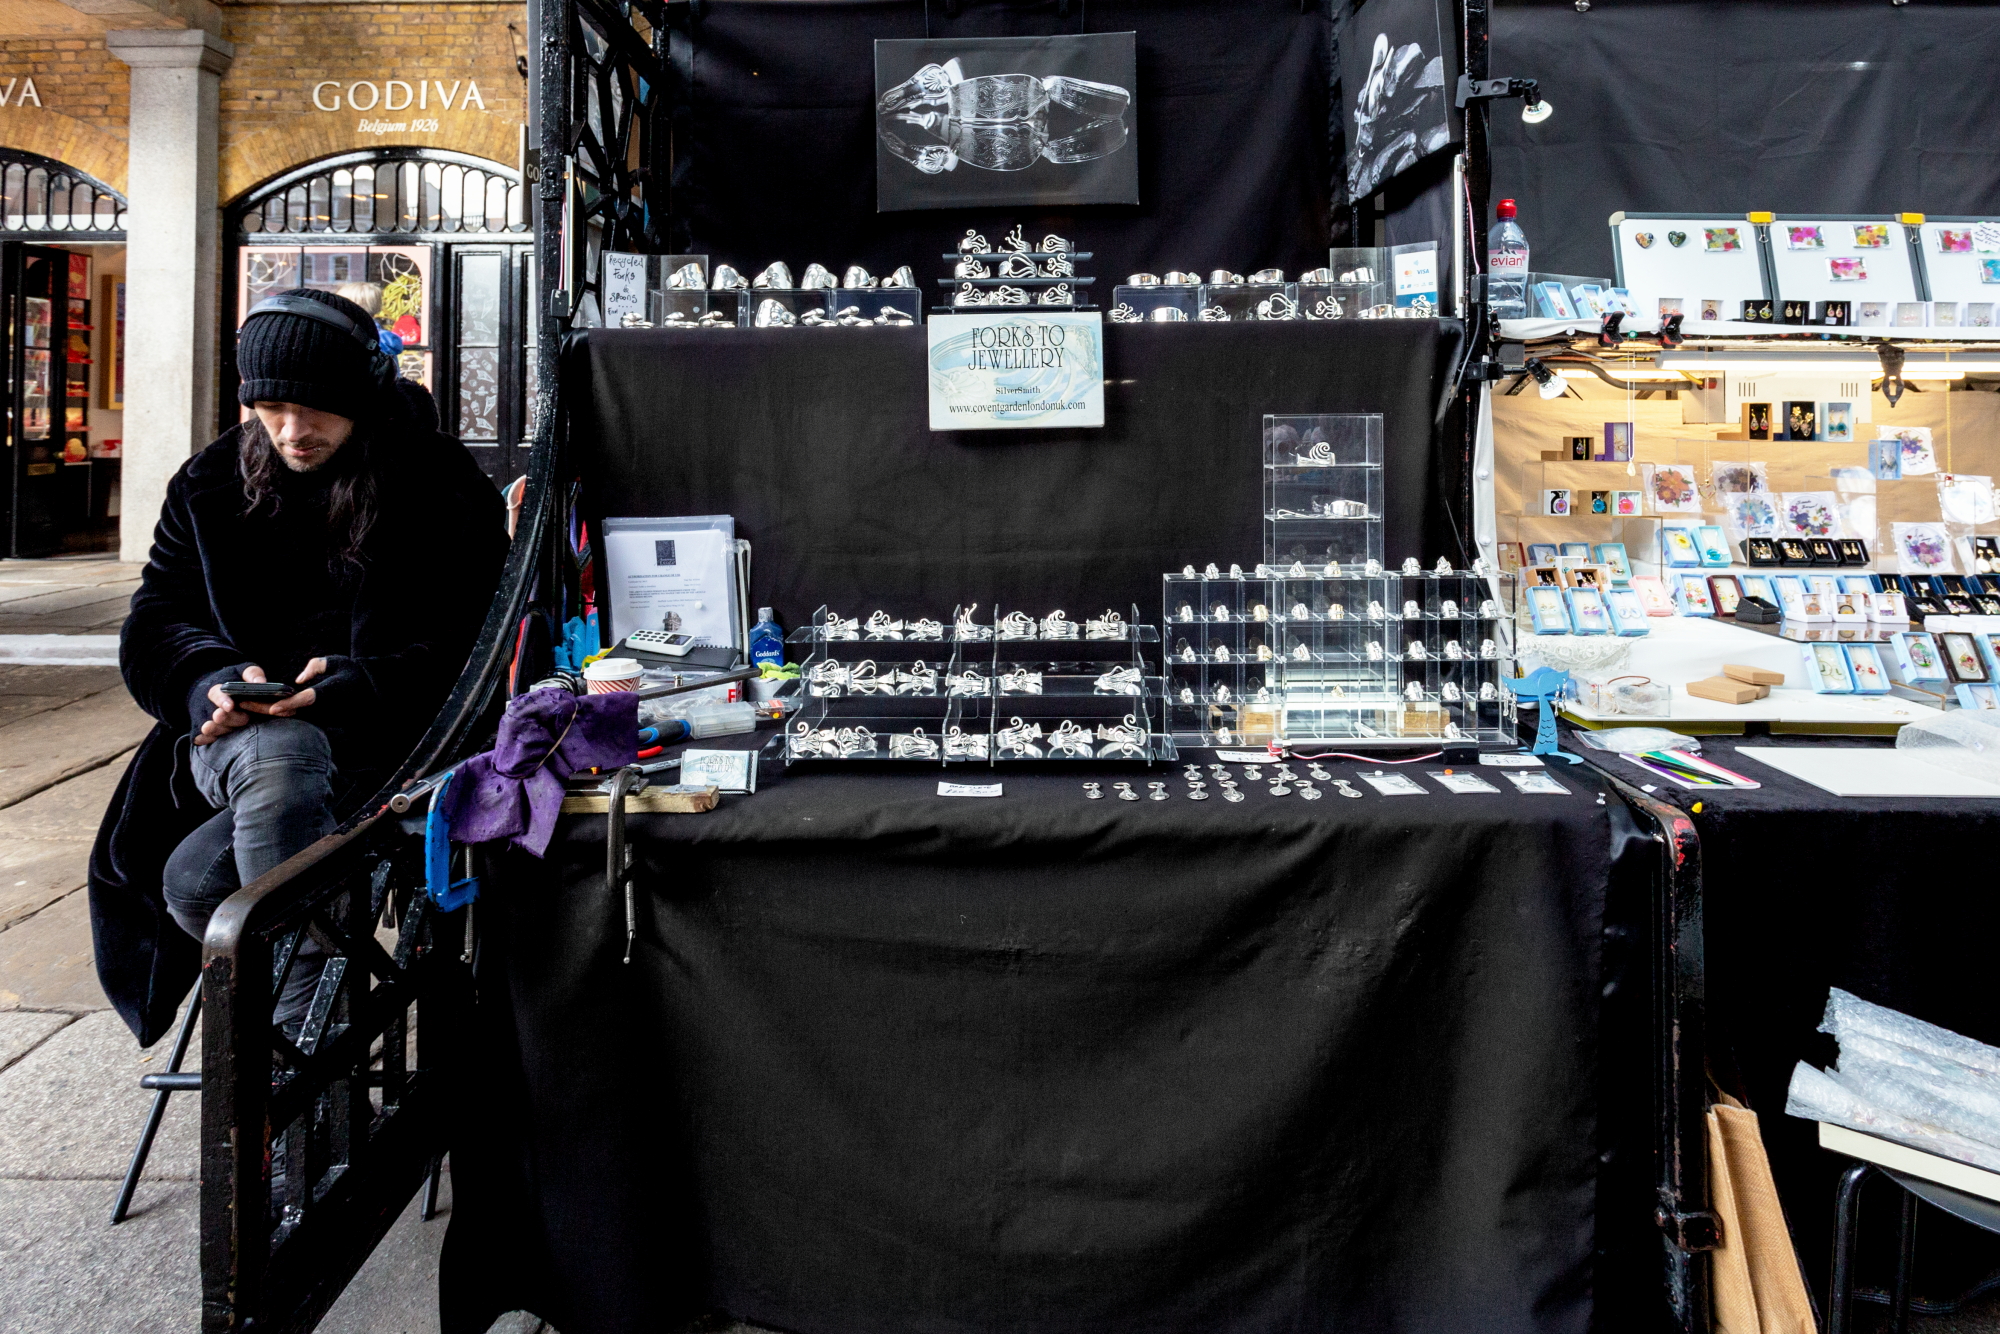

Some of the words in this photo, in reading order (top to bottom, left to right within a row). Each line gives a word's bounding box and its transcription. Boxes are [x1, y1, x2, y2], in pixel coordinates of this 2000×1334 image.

[312, 80, 486, 112] GODIVA
[357, 118, 406, 136] Belgium
[409, 118, 439, 132] 1926
[1490, 255, 1524, 267] evian
[971, 325, 1034, 349] FORKS
[1038, 324, 1065, 347] TO
[968, 347, 1065, 371] JEWELLERY
[949, 400, 1086, 415] www.coventgardenlondonuk.com
